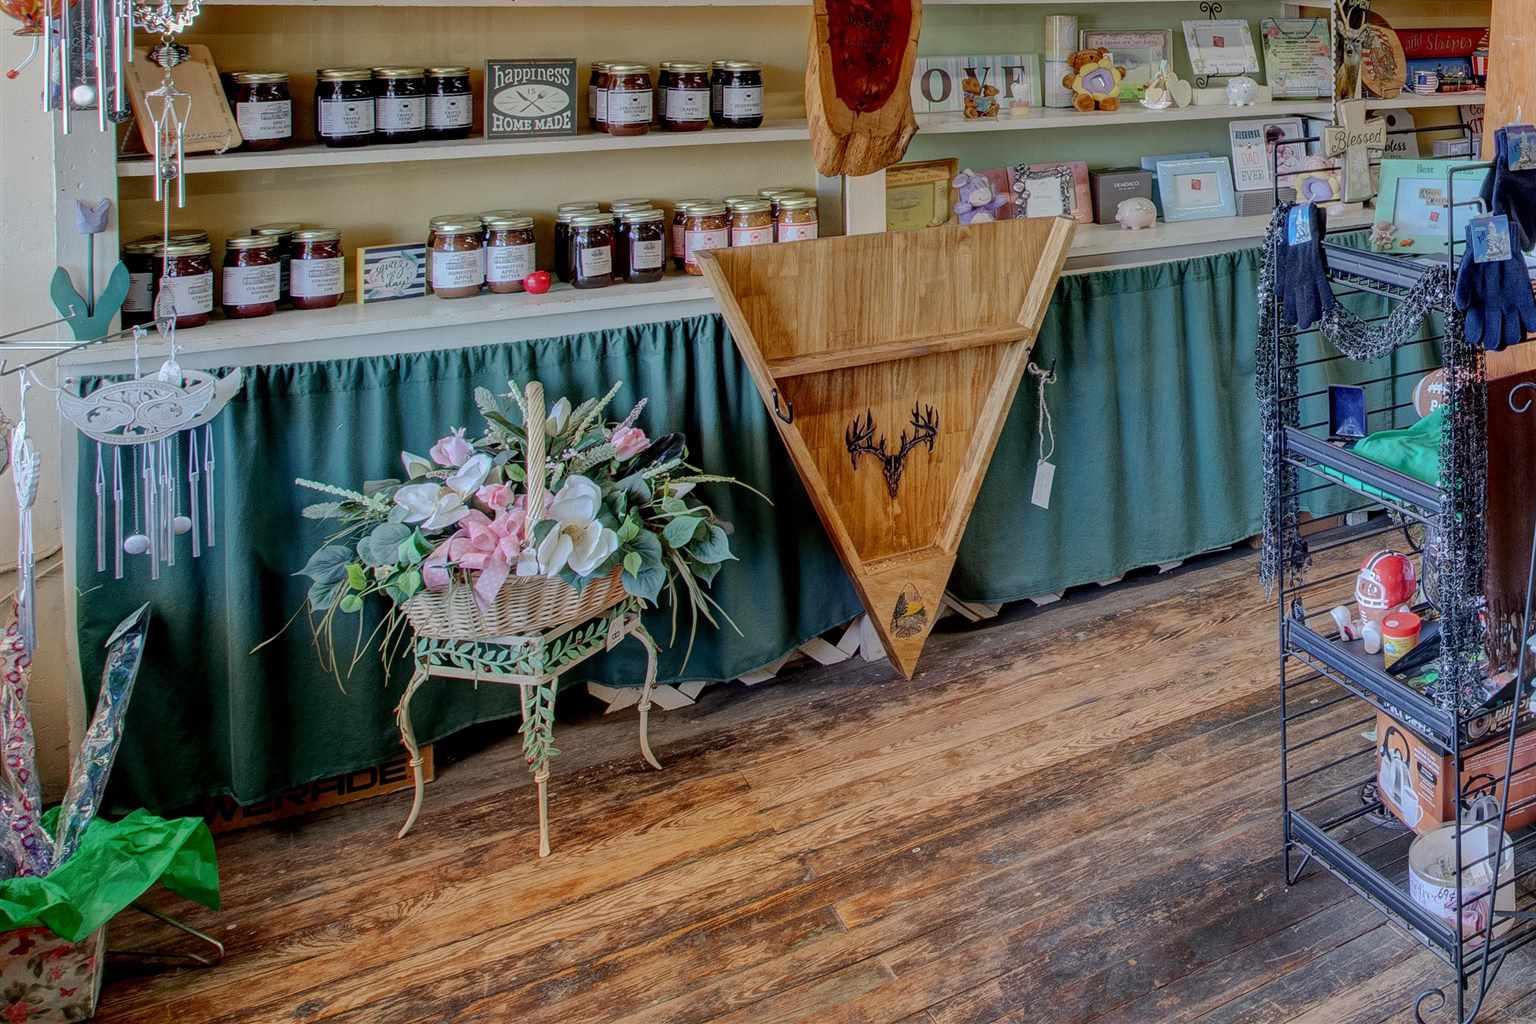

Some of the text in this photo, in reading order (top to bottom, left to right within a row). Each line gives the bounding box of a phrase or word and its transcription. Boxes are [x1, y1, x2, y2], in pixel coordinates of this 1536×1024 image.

[493, 64, 571, 89] happiness
[921, 67, 1025, 103] OVE
[492, 110, 572, 132] HOME MADE
[1331, 128, 1382, 154] Blessed
